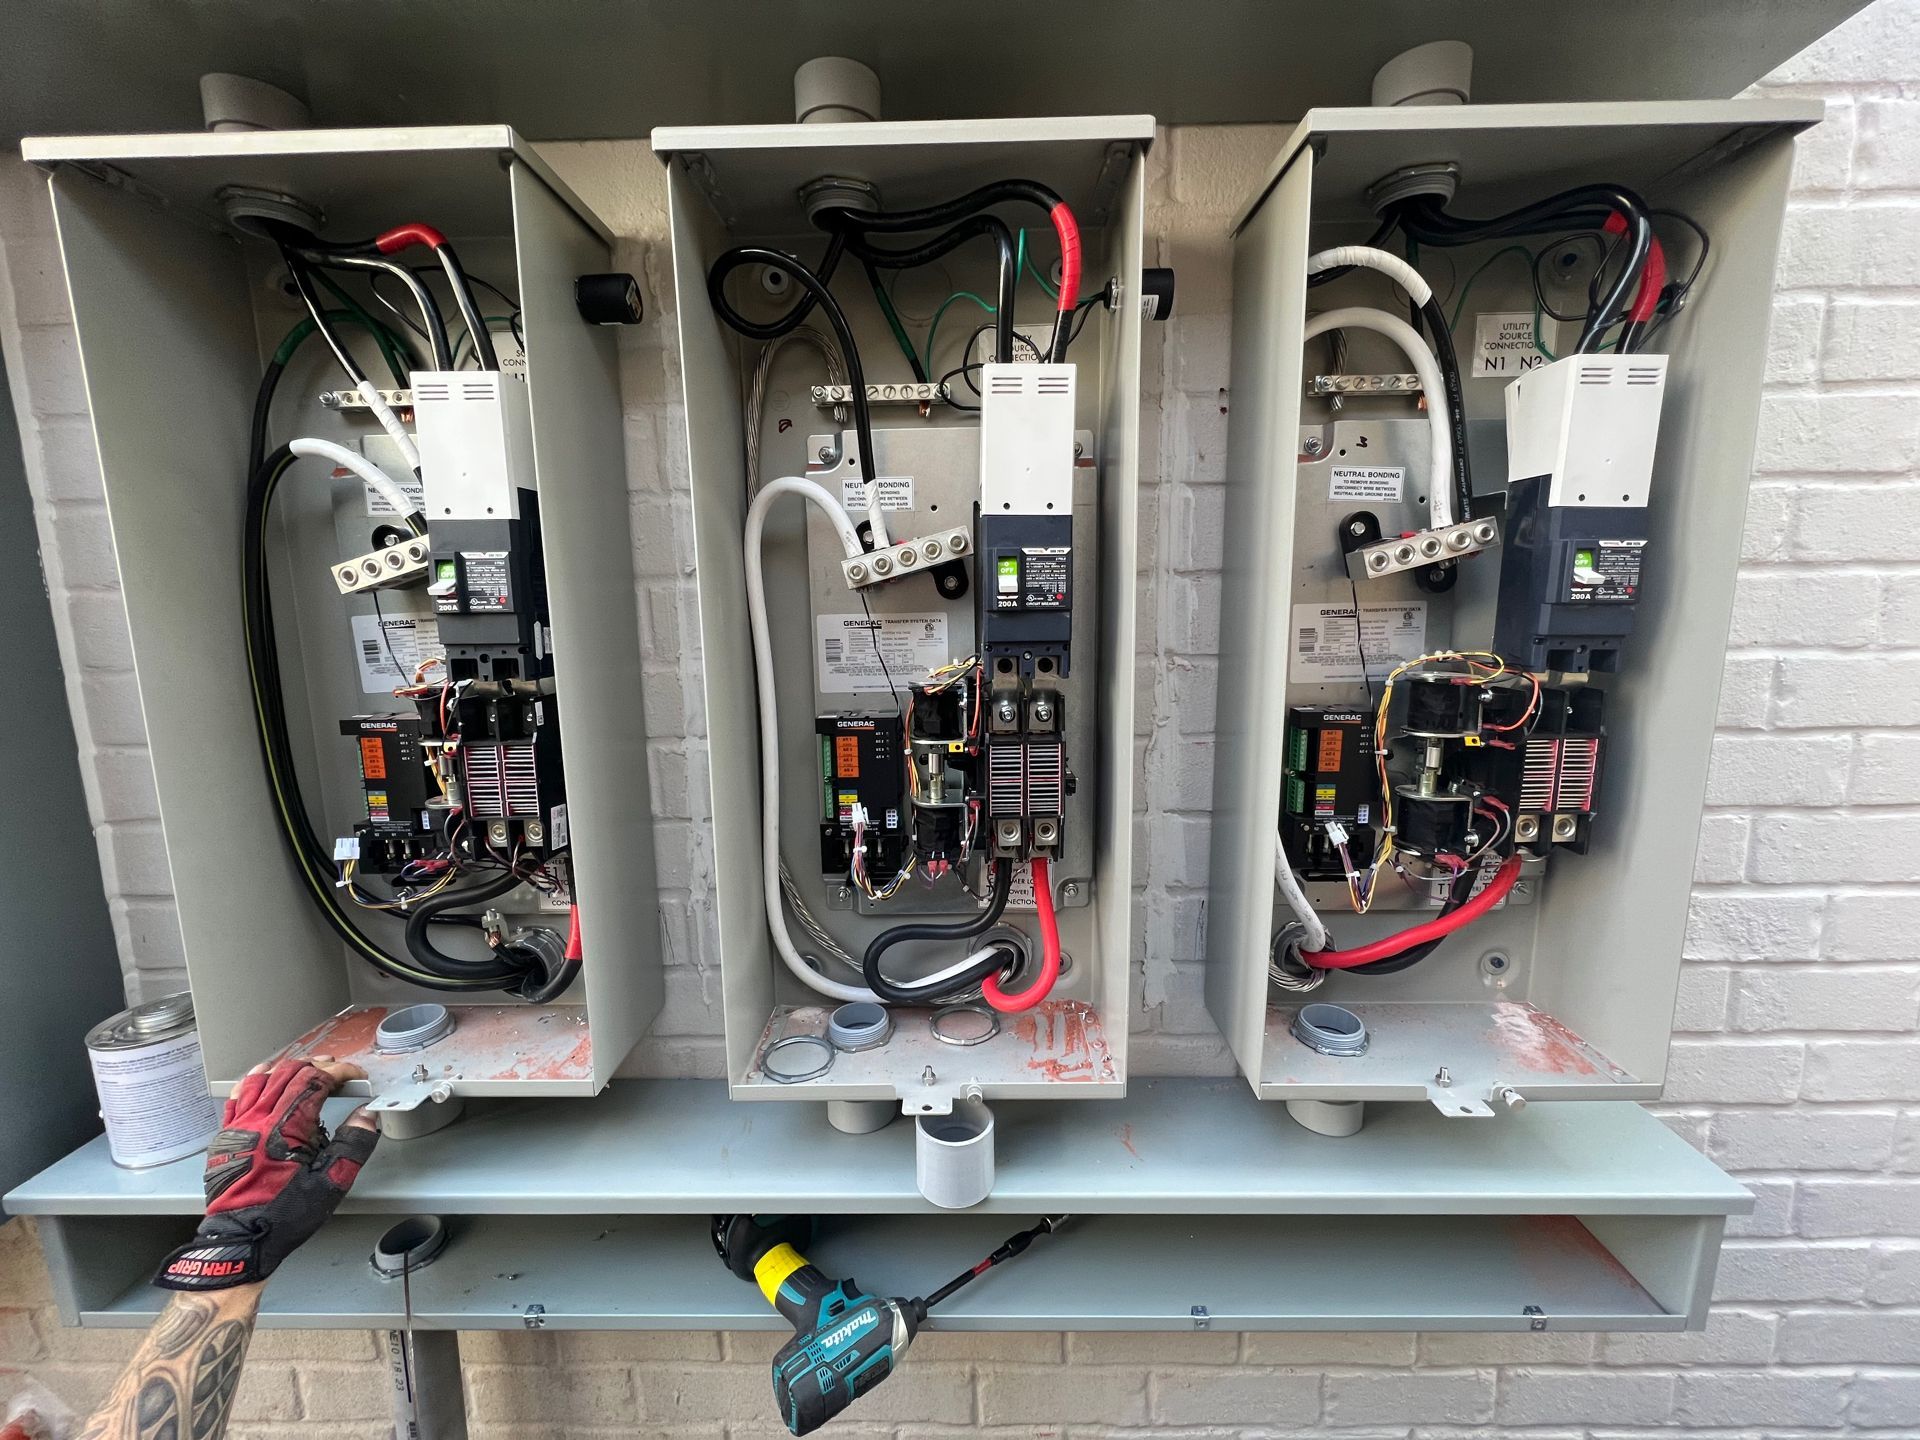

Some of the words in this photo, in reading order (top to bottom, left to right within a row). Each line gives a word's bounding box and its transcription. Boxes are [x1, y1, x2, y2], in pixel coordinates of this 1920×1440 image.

[1499, 332, 1532, 340] SOURCE
[1485, 356, 1505, 371] N1
[1333, 470, 1366, 478] NEUTRAL
[167, 1259, 203, 1276] GRIP
[201, 1261, 246, 1276] FIRM
[821, 1310, 877, 1349] makita
